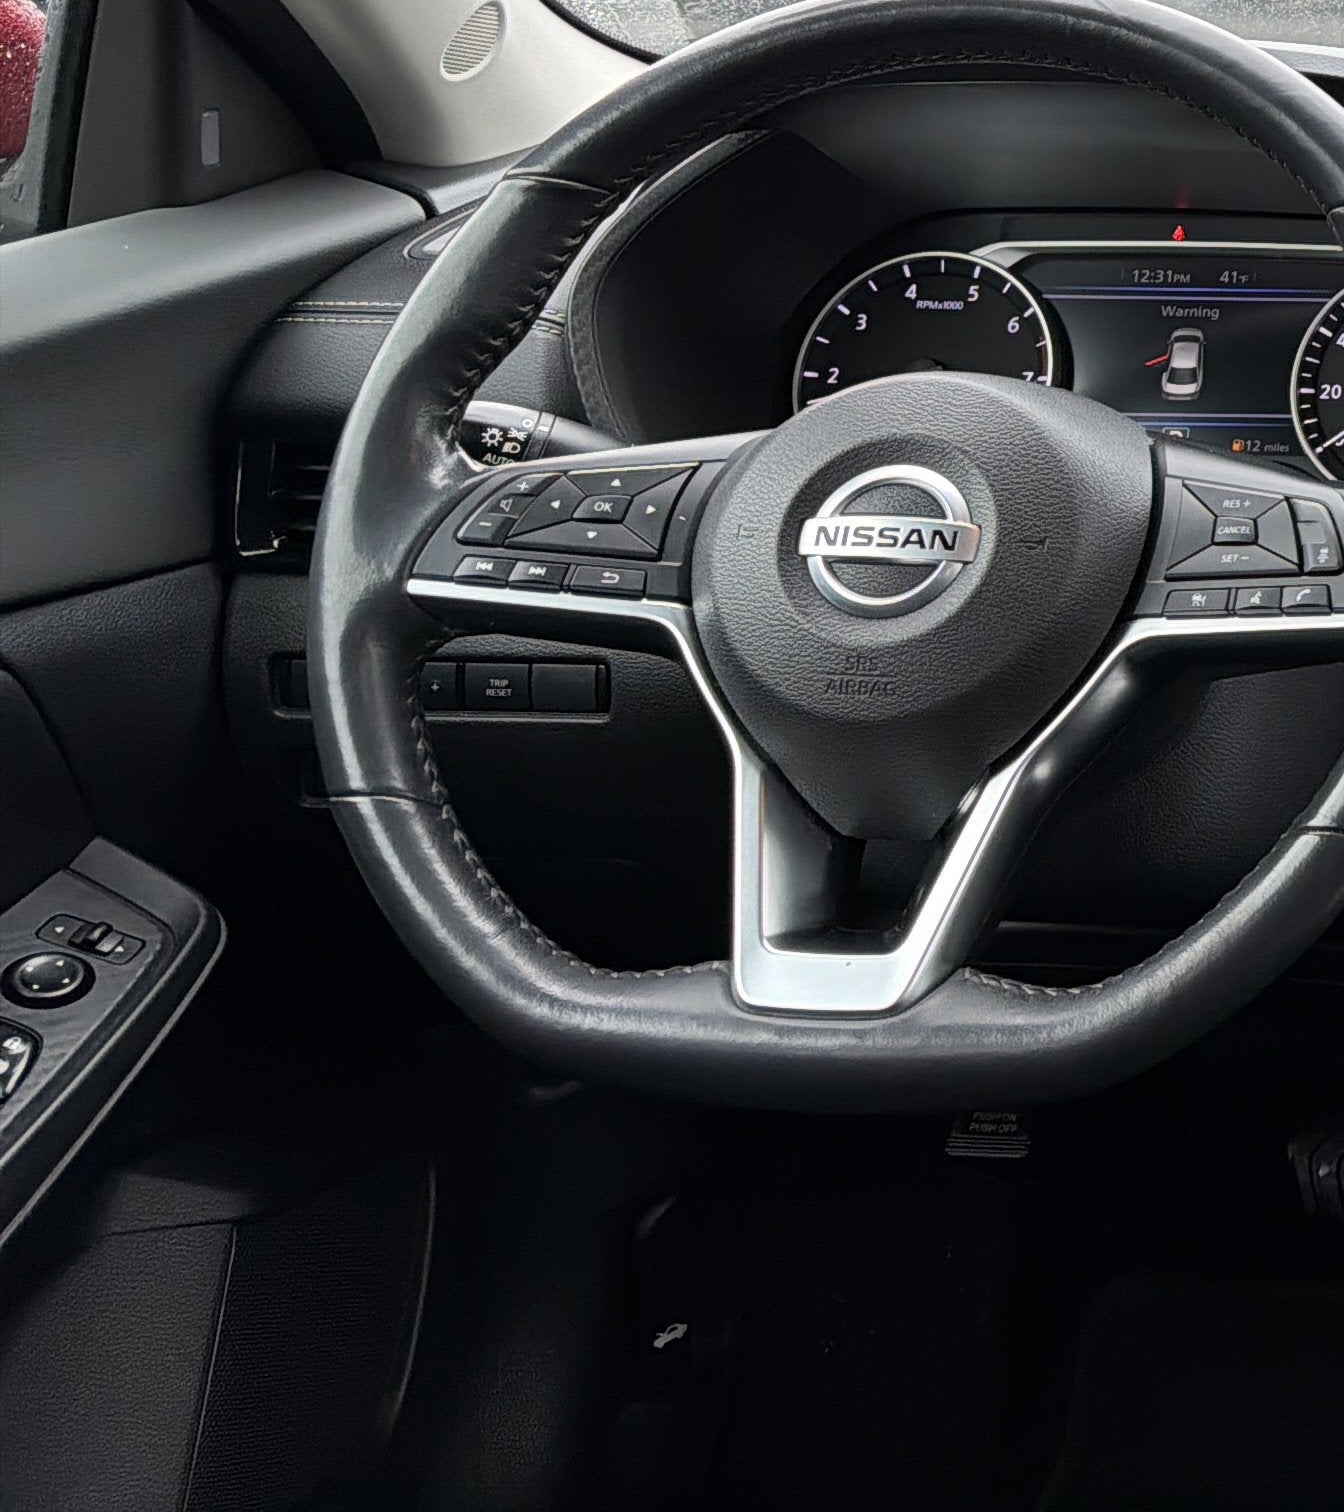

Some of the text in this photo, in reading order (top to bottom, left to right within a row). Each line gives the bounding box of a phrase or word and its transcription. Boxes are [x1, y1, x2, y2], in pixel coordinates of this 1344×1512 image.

[904, 283, 917, 300] 4
[967, 285, 980, 302] 5
[1161, 305, 1220, 321] Warning
[855, 314, 868, 331] 3
[1007, 316, 1020, 334] 6
[826, 367, 839, 384] 2
[1319, 384, 1342, 400] 20
[1246, 439, 1290, 453] 12 miles
[593, 500, 614, 514] OK
[1222, 498, 1241, 509] RES
[1217, 524, 1252, 535] CANCEL
[813, 525, 959, 552] NISSAN
[1220, 553, 1238, 563] SET
[489, 678, 510, 688] TRIP
[485, 688, 513, 698] RESET
